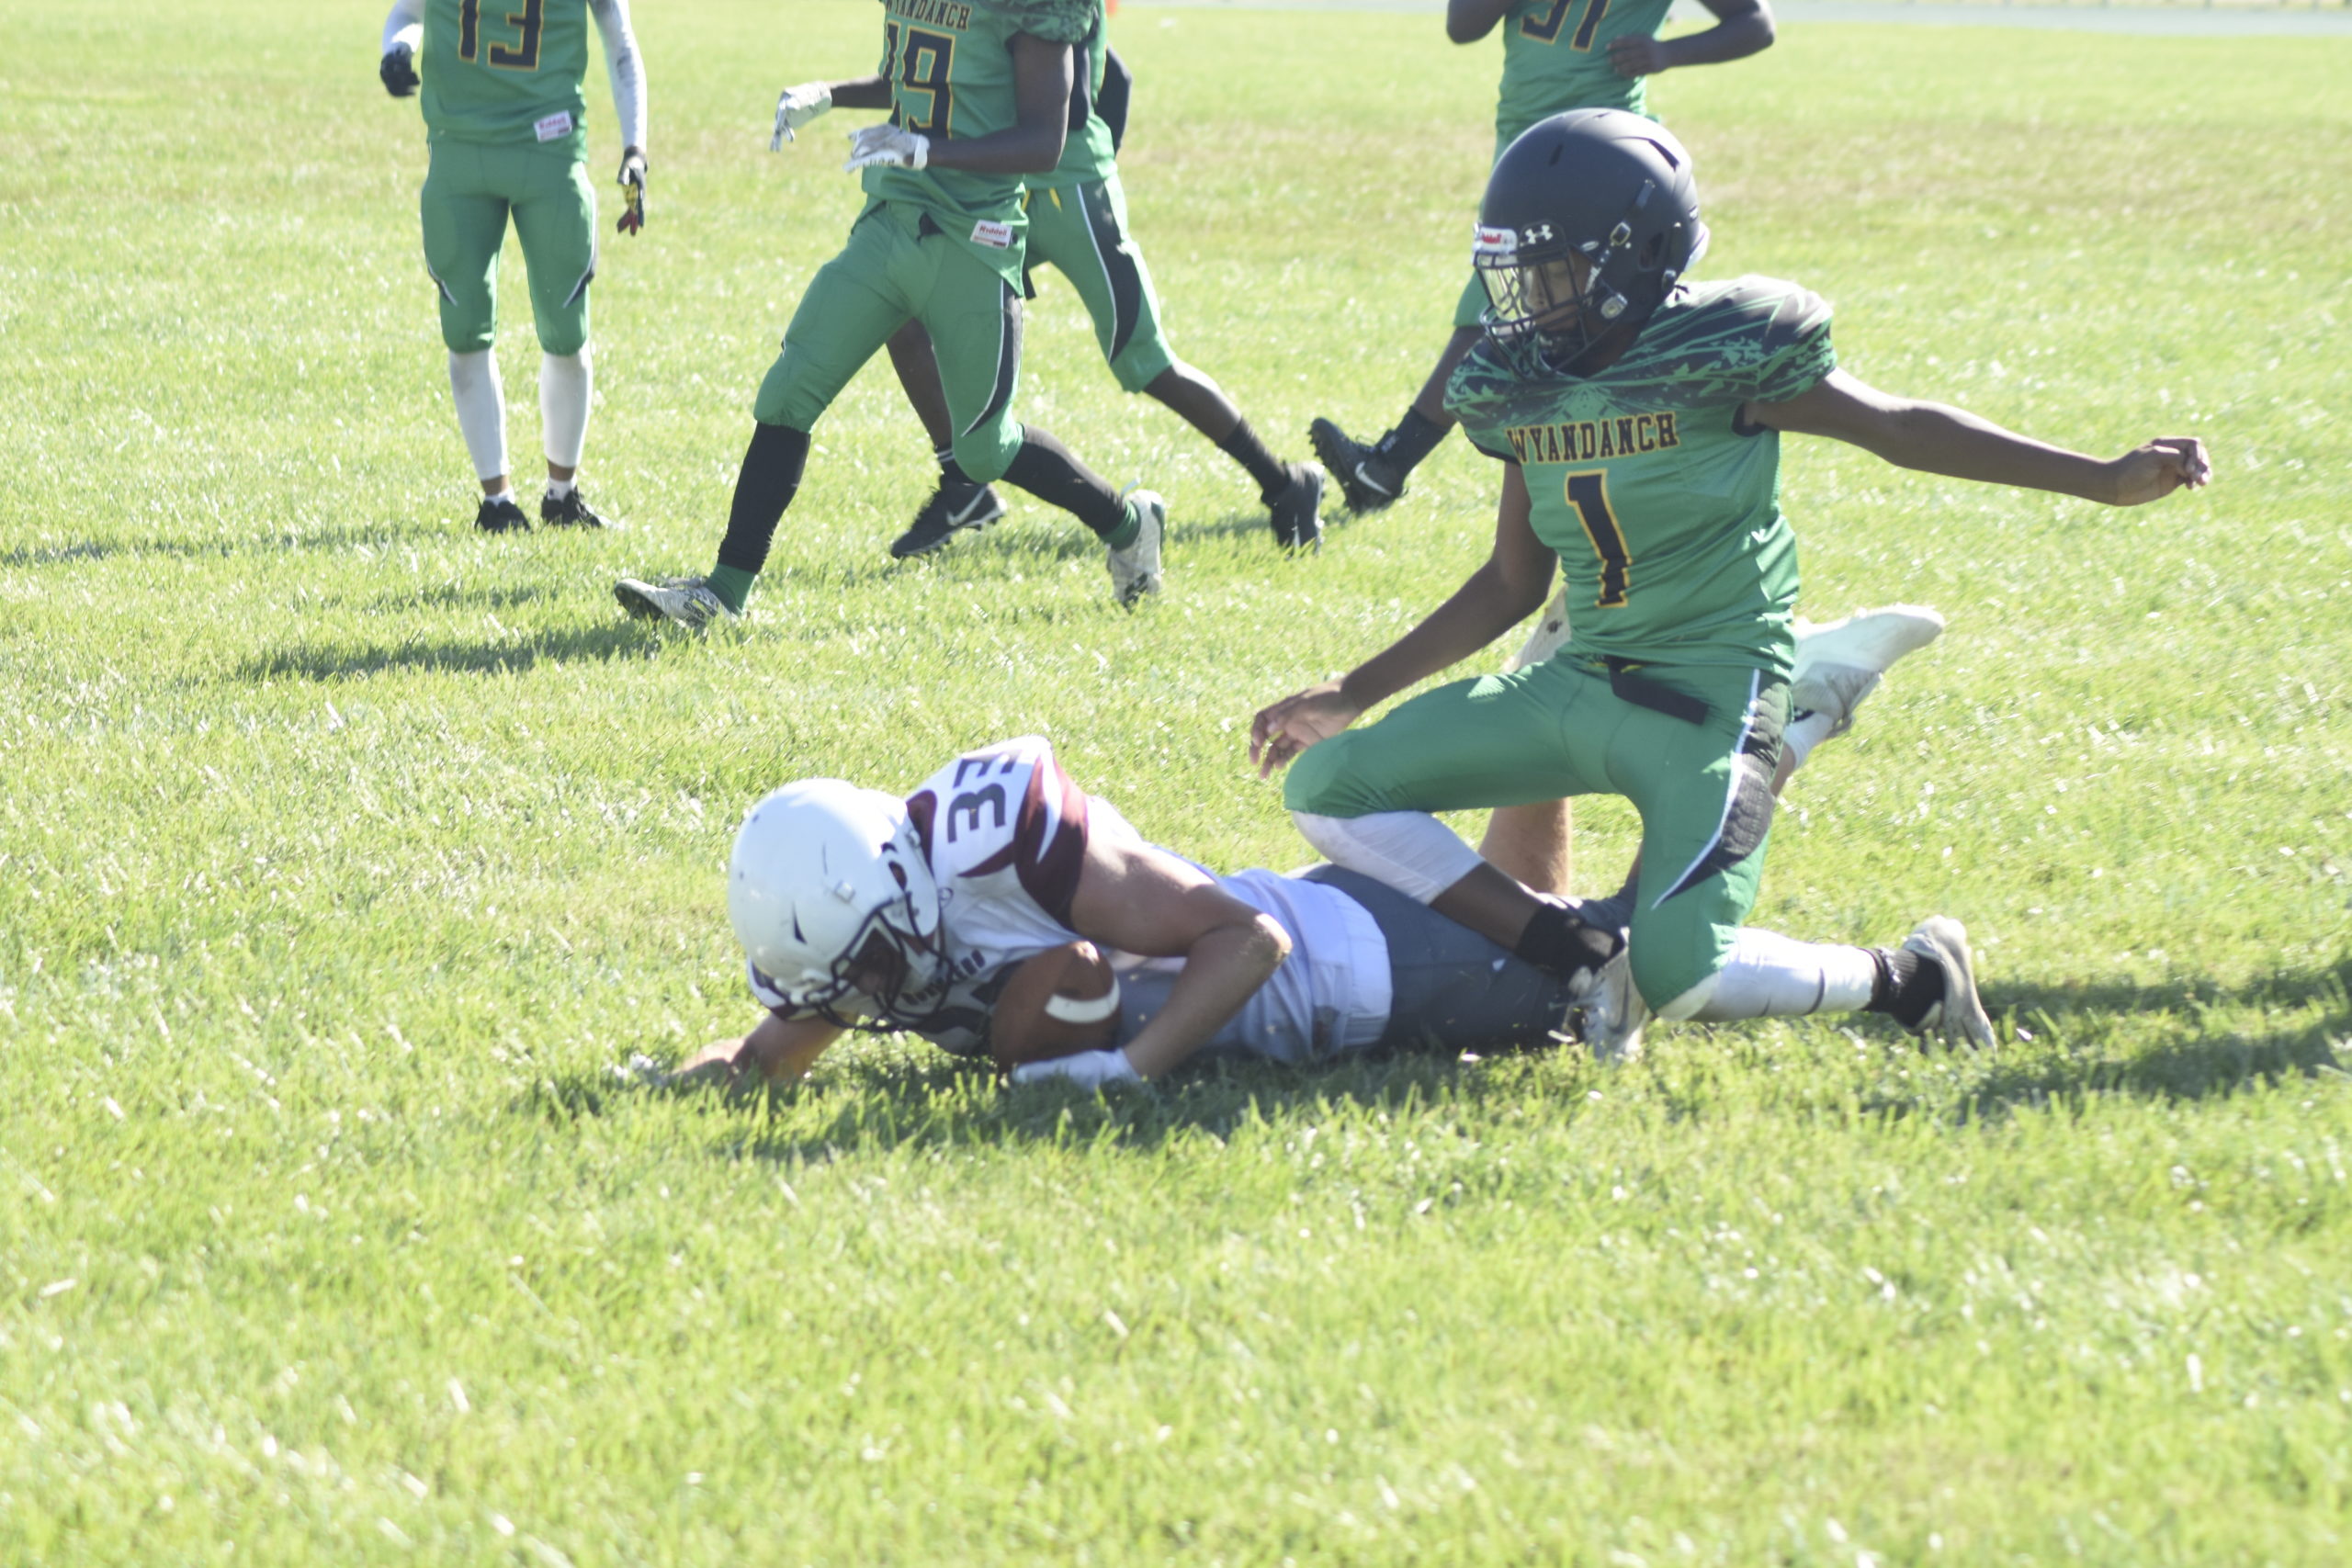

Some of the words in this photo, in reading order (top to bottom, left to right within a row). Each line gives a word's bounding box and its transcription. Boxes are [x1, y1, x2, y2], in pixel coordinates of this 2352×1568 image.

[458, 0, 545, 71] 13
[879, 20, 956, 140] 19
[1505, 412, 1679, 465] WYANDANCH
[1565, 468, 1633, 608] 1
